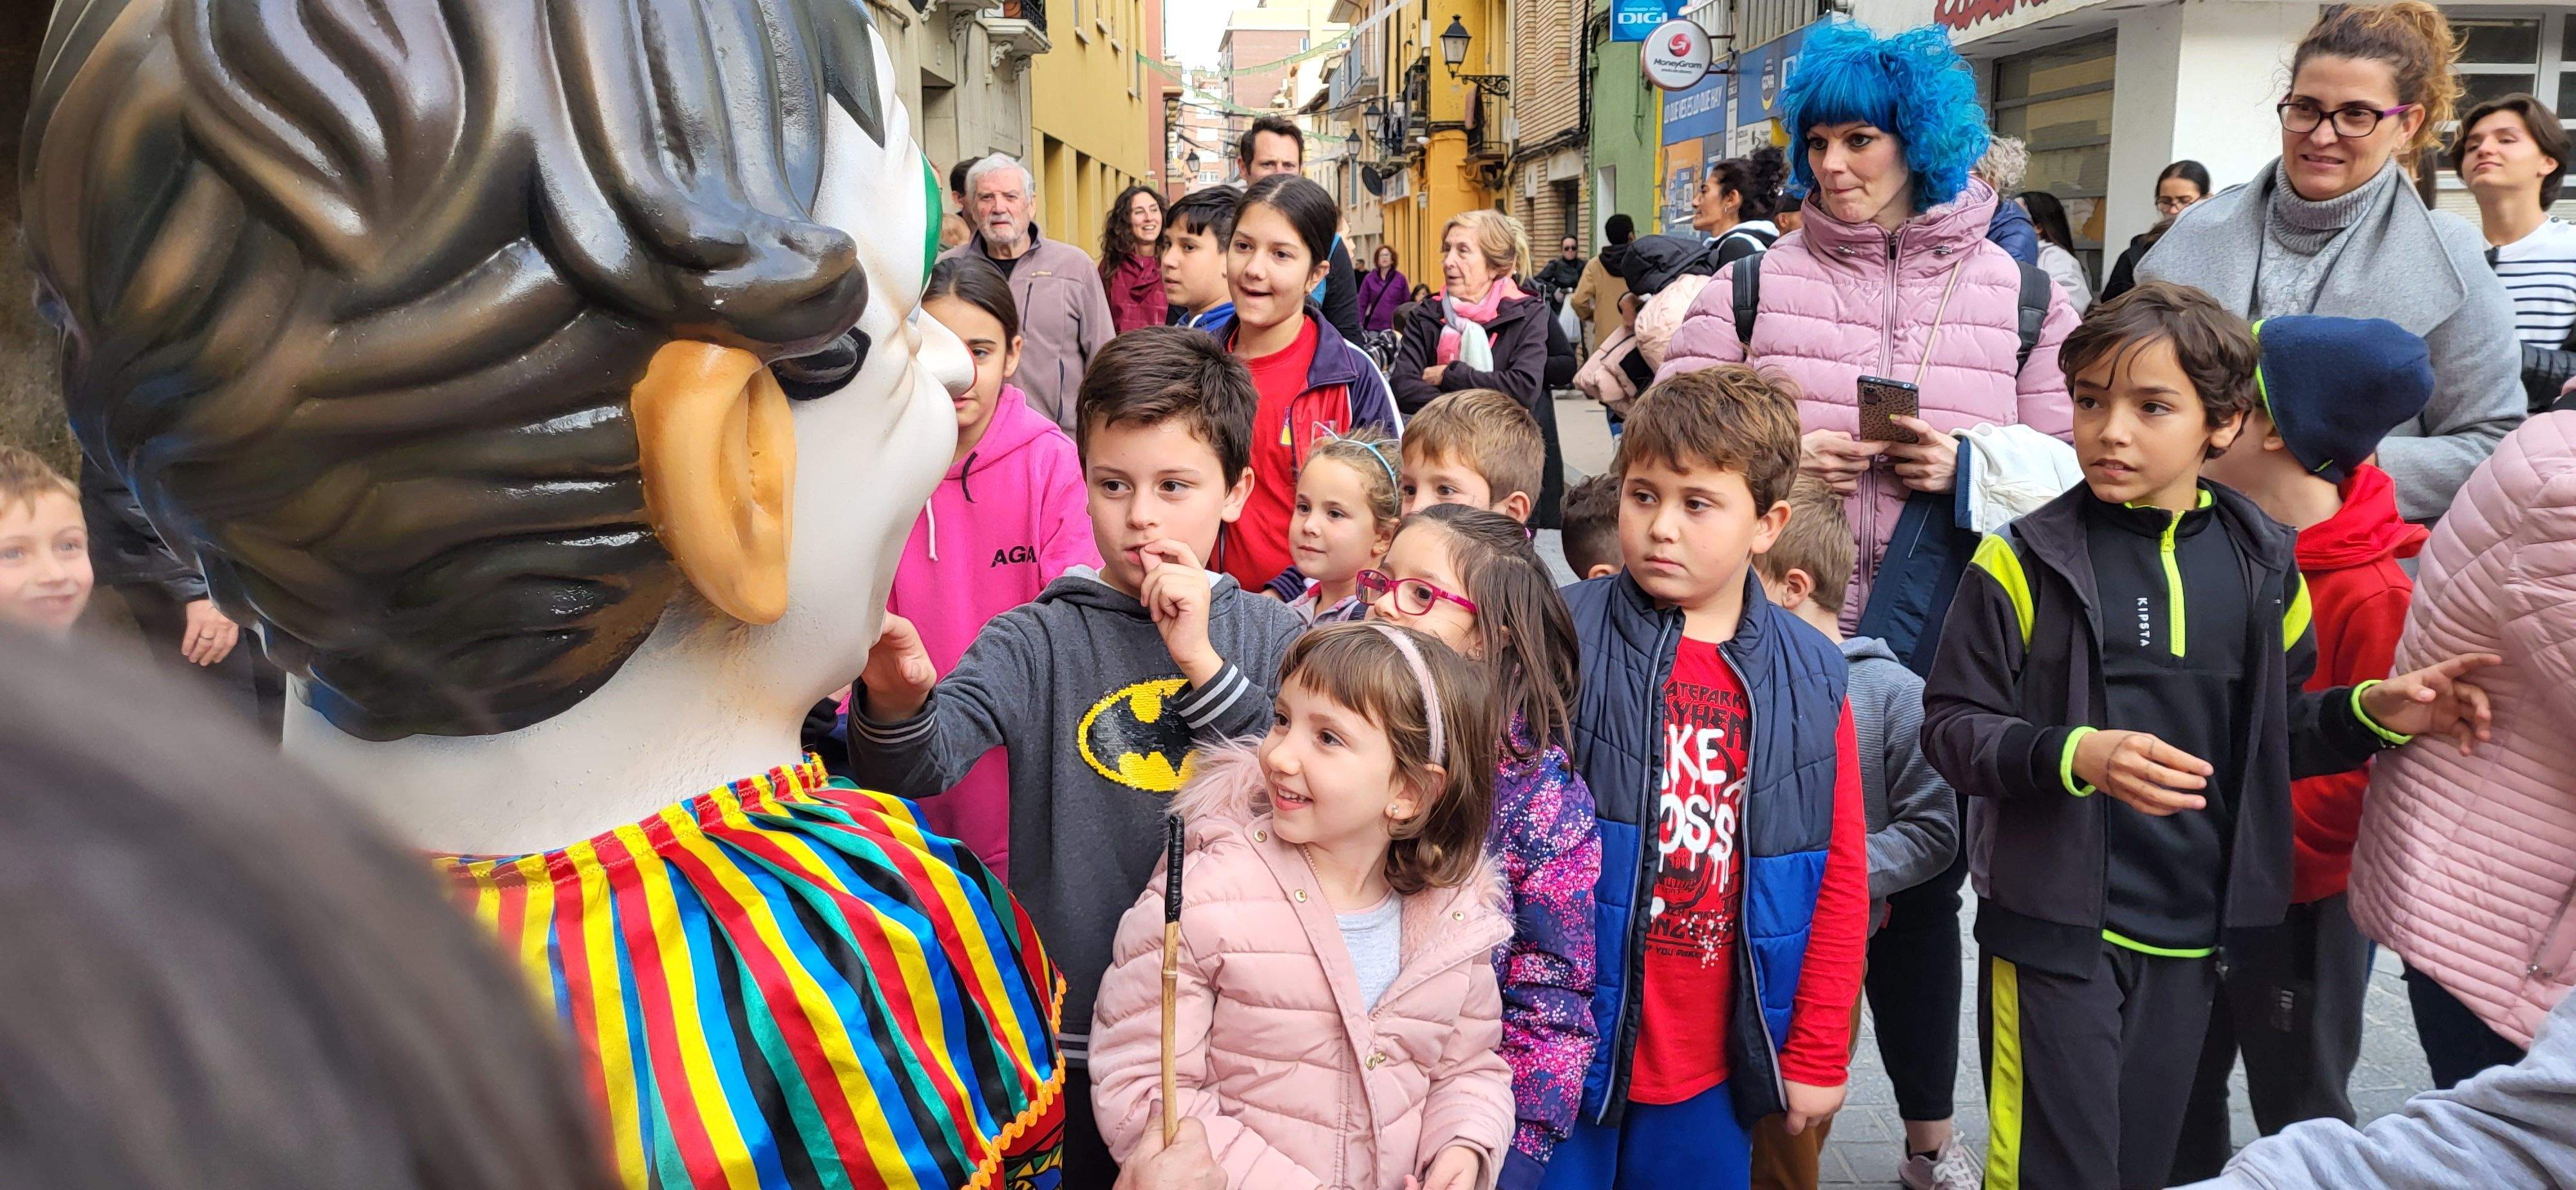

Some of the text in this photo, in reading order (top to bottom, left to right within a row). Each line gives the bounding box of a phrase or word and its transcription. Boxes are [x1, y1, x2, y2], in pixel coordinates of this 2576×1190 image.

[1617, 12, 1668, 24] DIGI
[1653, 58, 1702, 69] MoneyGram
[990, 545, 1037, 568] AGA
[2137, 598, 2150, 647] KIPSTA
[1665, 681, 1744, 709] ATEPARK
[1664, 699, 1750, 751] AYHEM
[1662, 723, 1727, 795] KE
[1659, 793, 1736, 861] OSS
